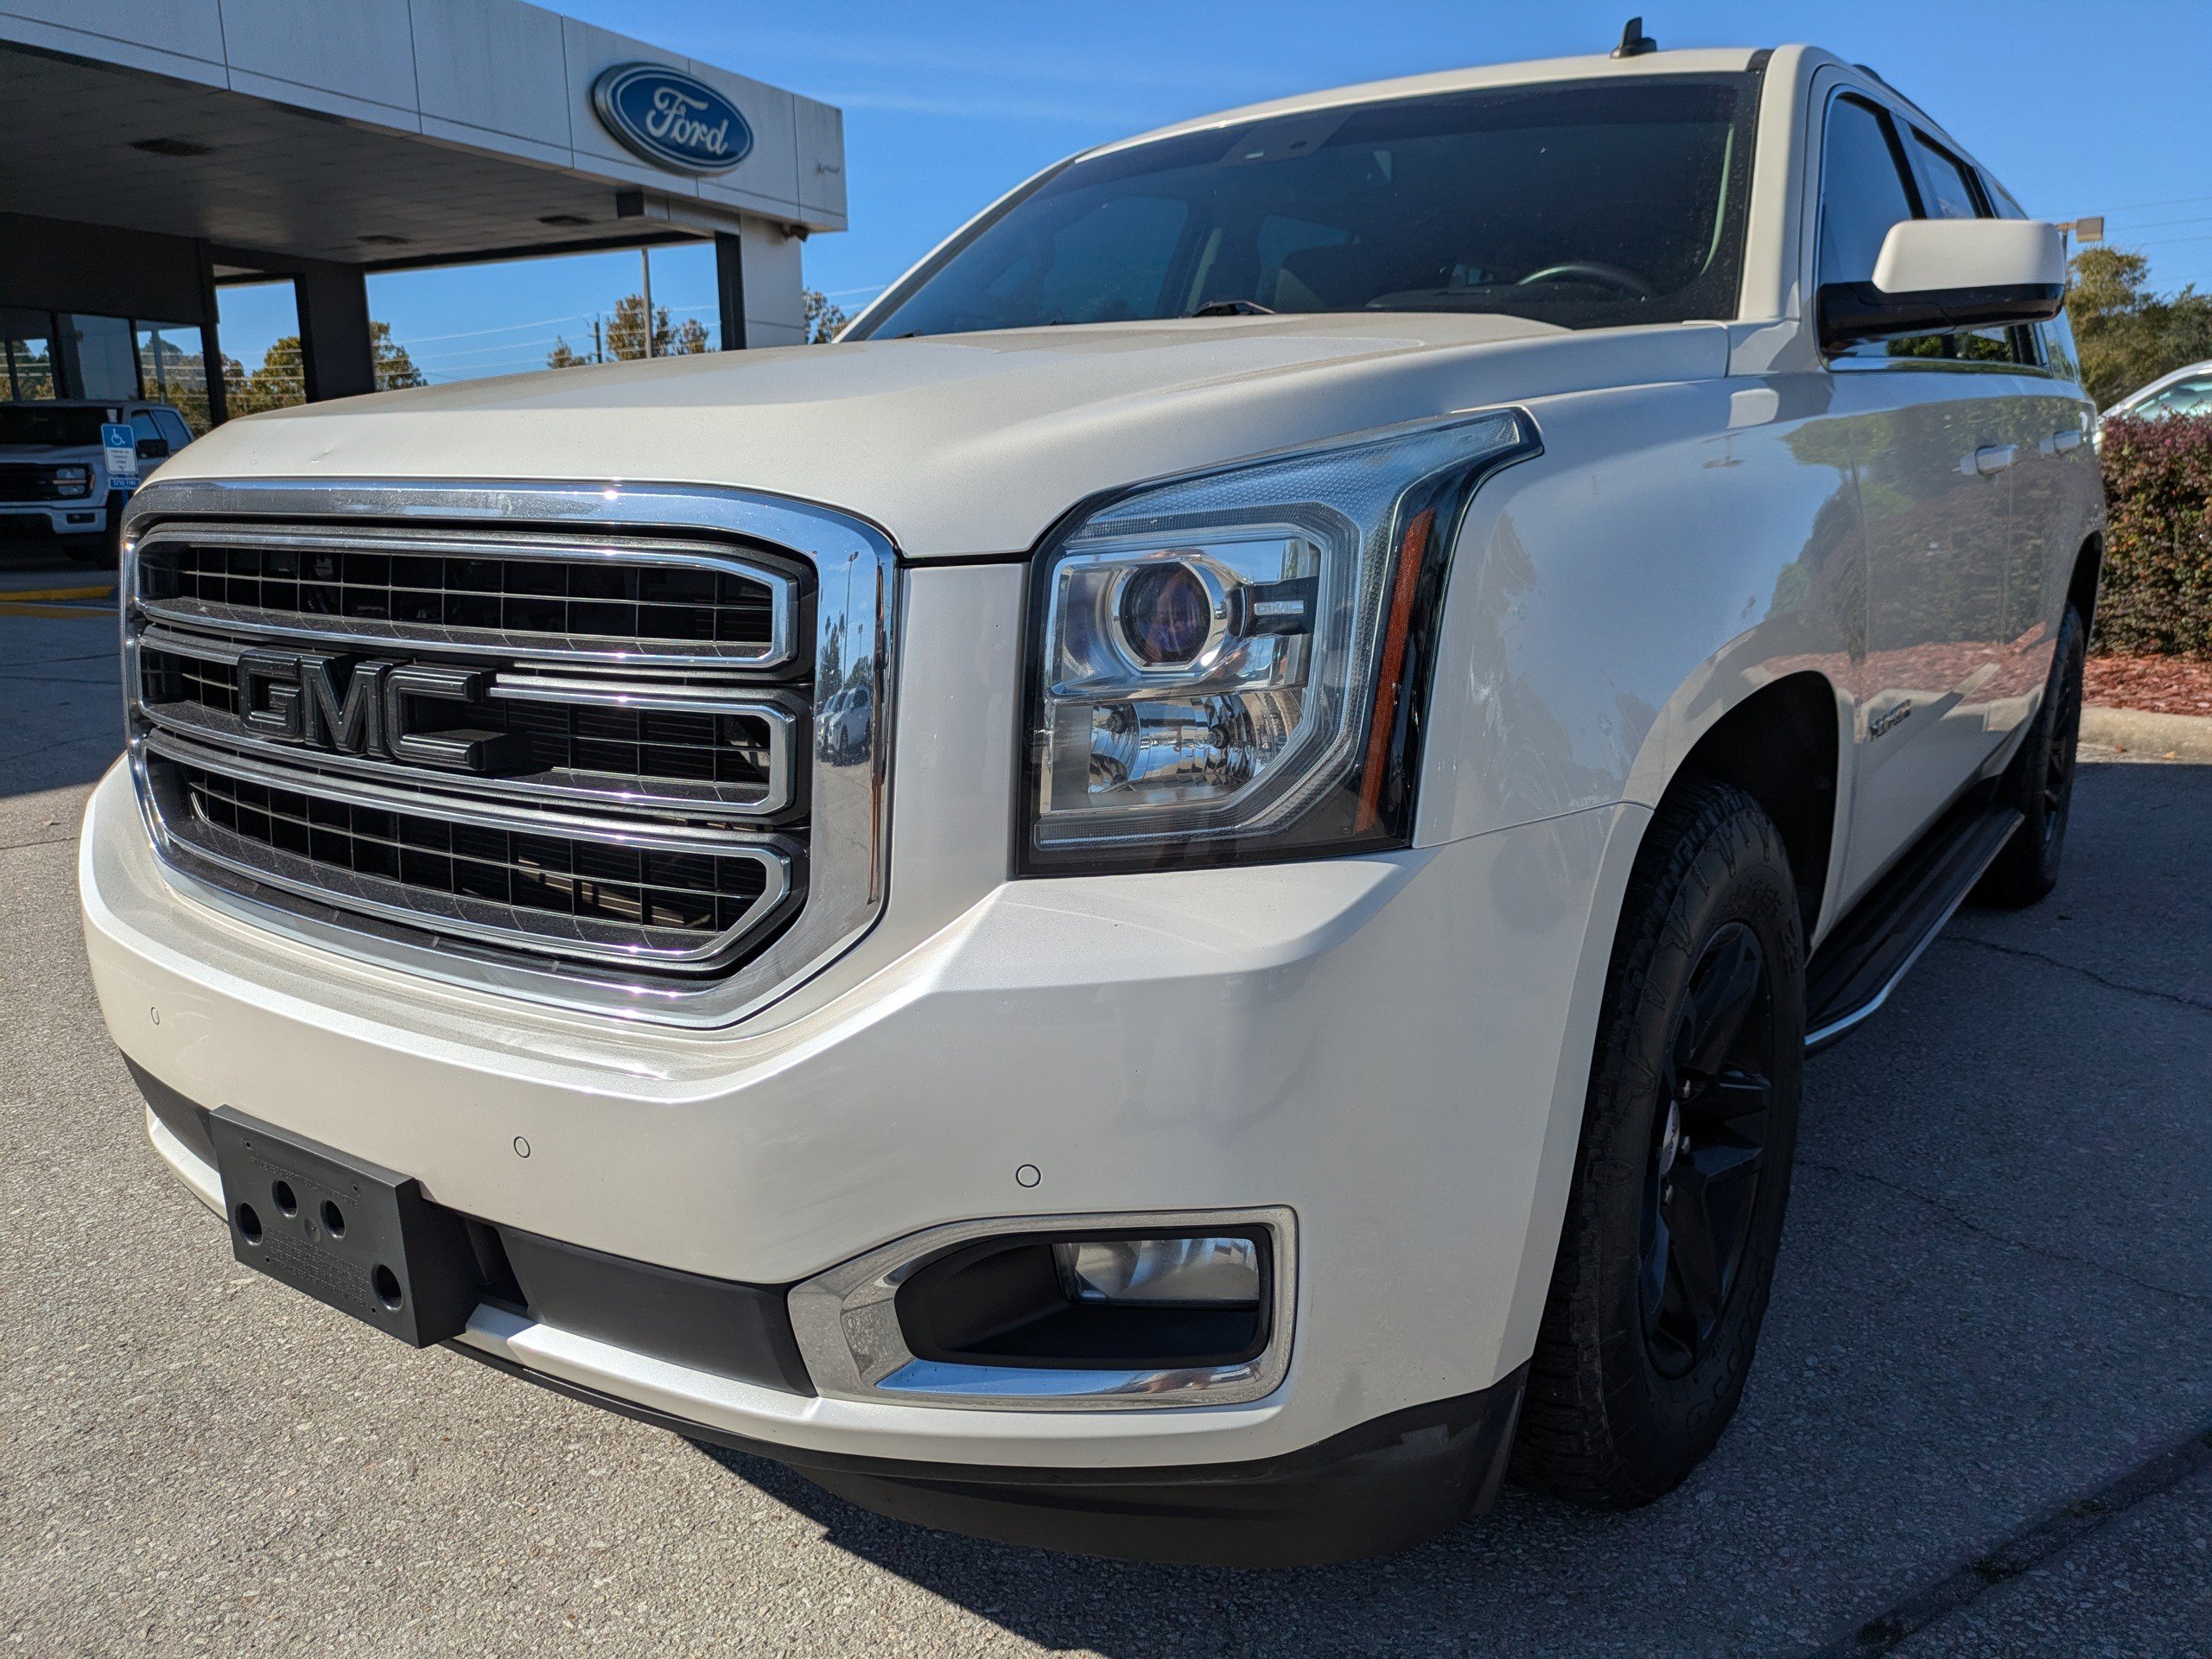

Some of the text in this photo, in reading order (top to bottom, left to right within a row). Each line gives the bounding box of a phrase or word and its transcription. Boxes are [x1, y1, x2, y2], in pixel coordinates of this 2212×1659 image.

[646, 86, 729, 156] Ford
[1254, 601, 1304, 615] GMC
[237, 648, 494, 772] GMC
